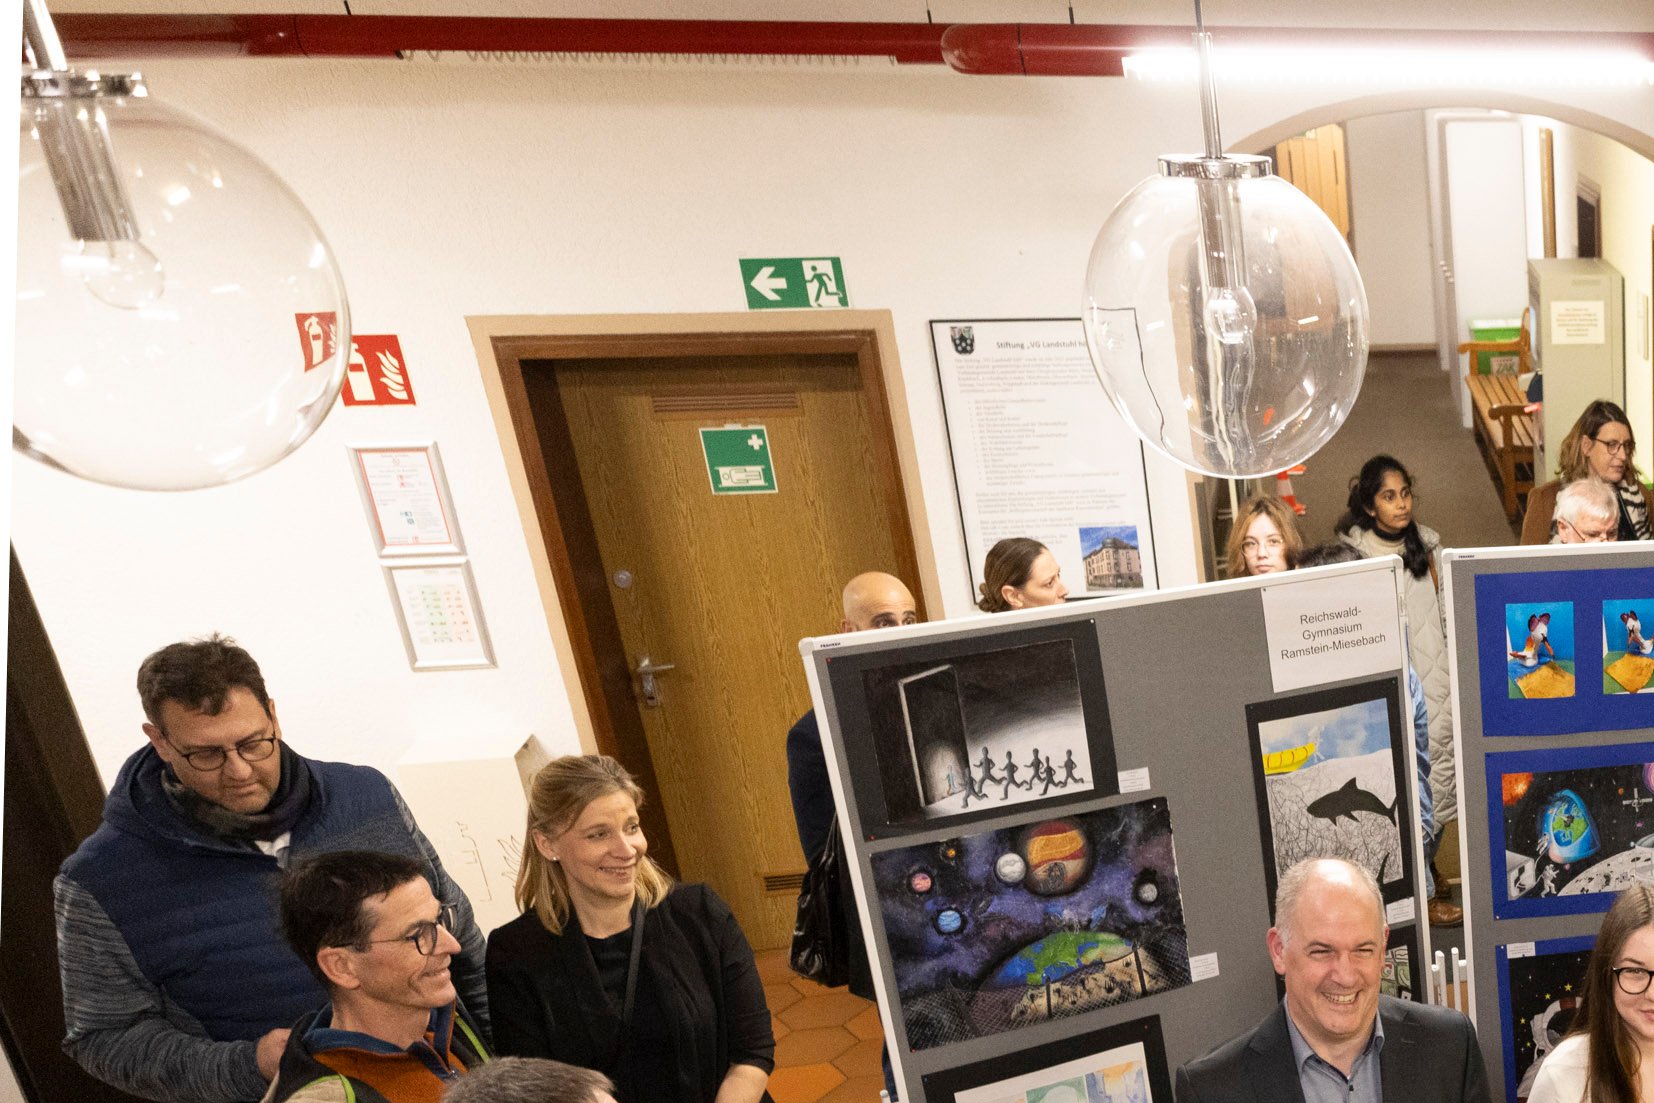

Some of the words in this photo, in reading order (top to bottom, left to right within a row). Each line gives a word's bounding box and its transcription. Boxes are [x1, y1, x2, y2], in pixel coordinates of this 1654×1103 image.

[996, 341, 1025, 350] Stiftung
[1042, 340, 1077, 349] Landstuhl
[1300, 606, 1361, 625] Reichswald-
[1302, 623, 1363, 642] Gymnasium
[1281, 633, 1386, 660] Ramstein-Miesebach
